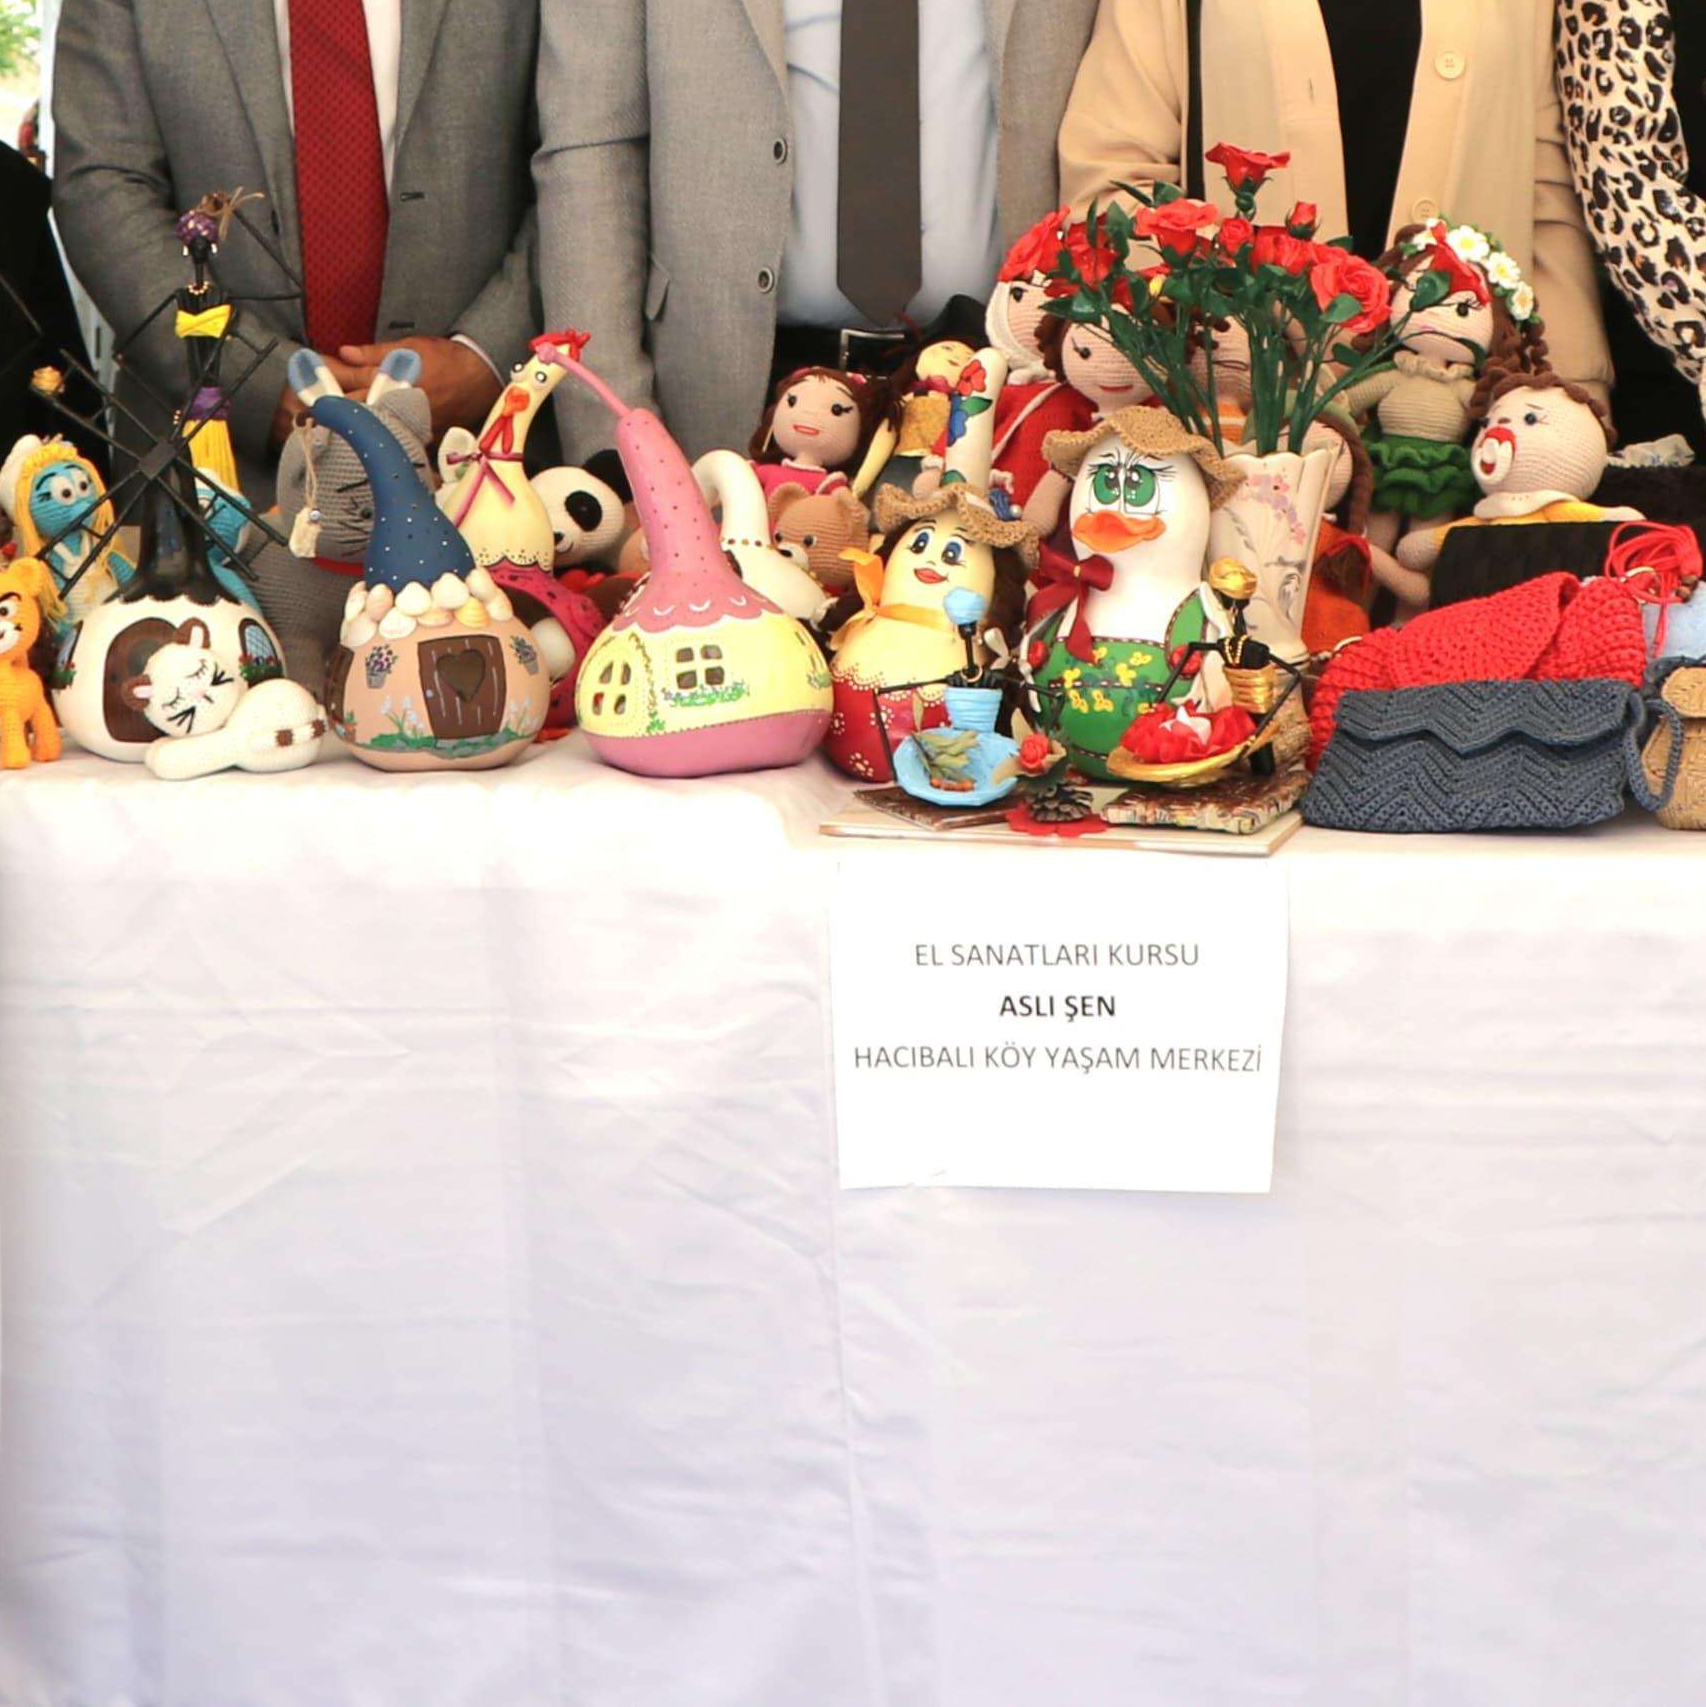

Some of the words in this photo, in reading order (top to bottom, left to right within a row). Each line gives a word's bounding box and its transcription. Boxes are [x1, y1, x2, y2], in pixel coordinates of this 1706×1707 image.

[915, 943, 944, 967] EL
[950, 943, 1098, 967] SANATLARI
[1108, 943, 1200, 967] KURSU
[999, 994, 1055, 1018] ASLI
[1064, 994, 1116, 1023] ŞEN
[854, 1045, 975, 1069] HACIBALI
[984, 1040, 1037, 1069] KÖY
[1044, 1045, 1140, 1075] YAŞAM
[1150, 1043, 1262, 1072] MERKEZİ
